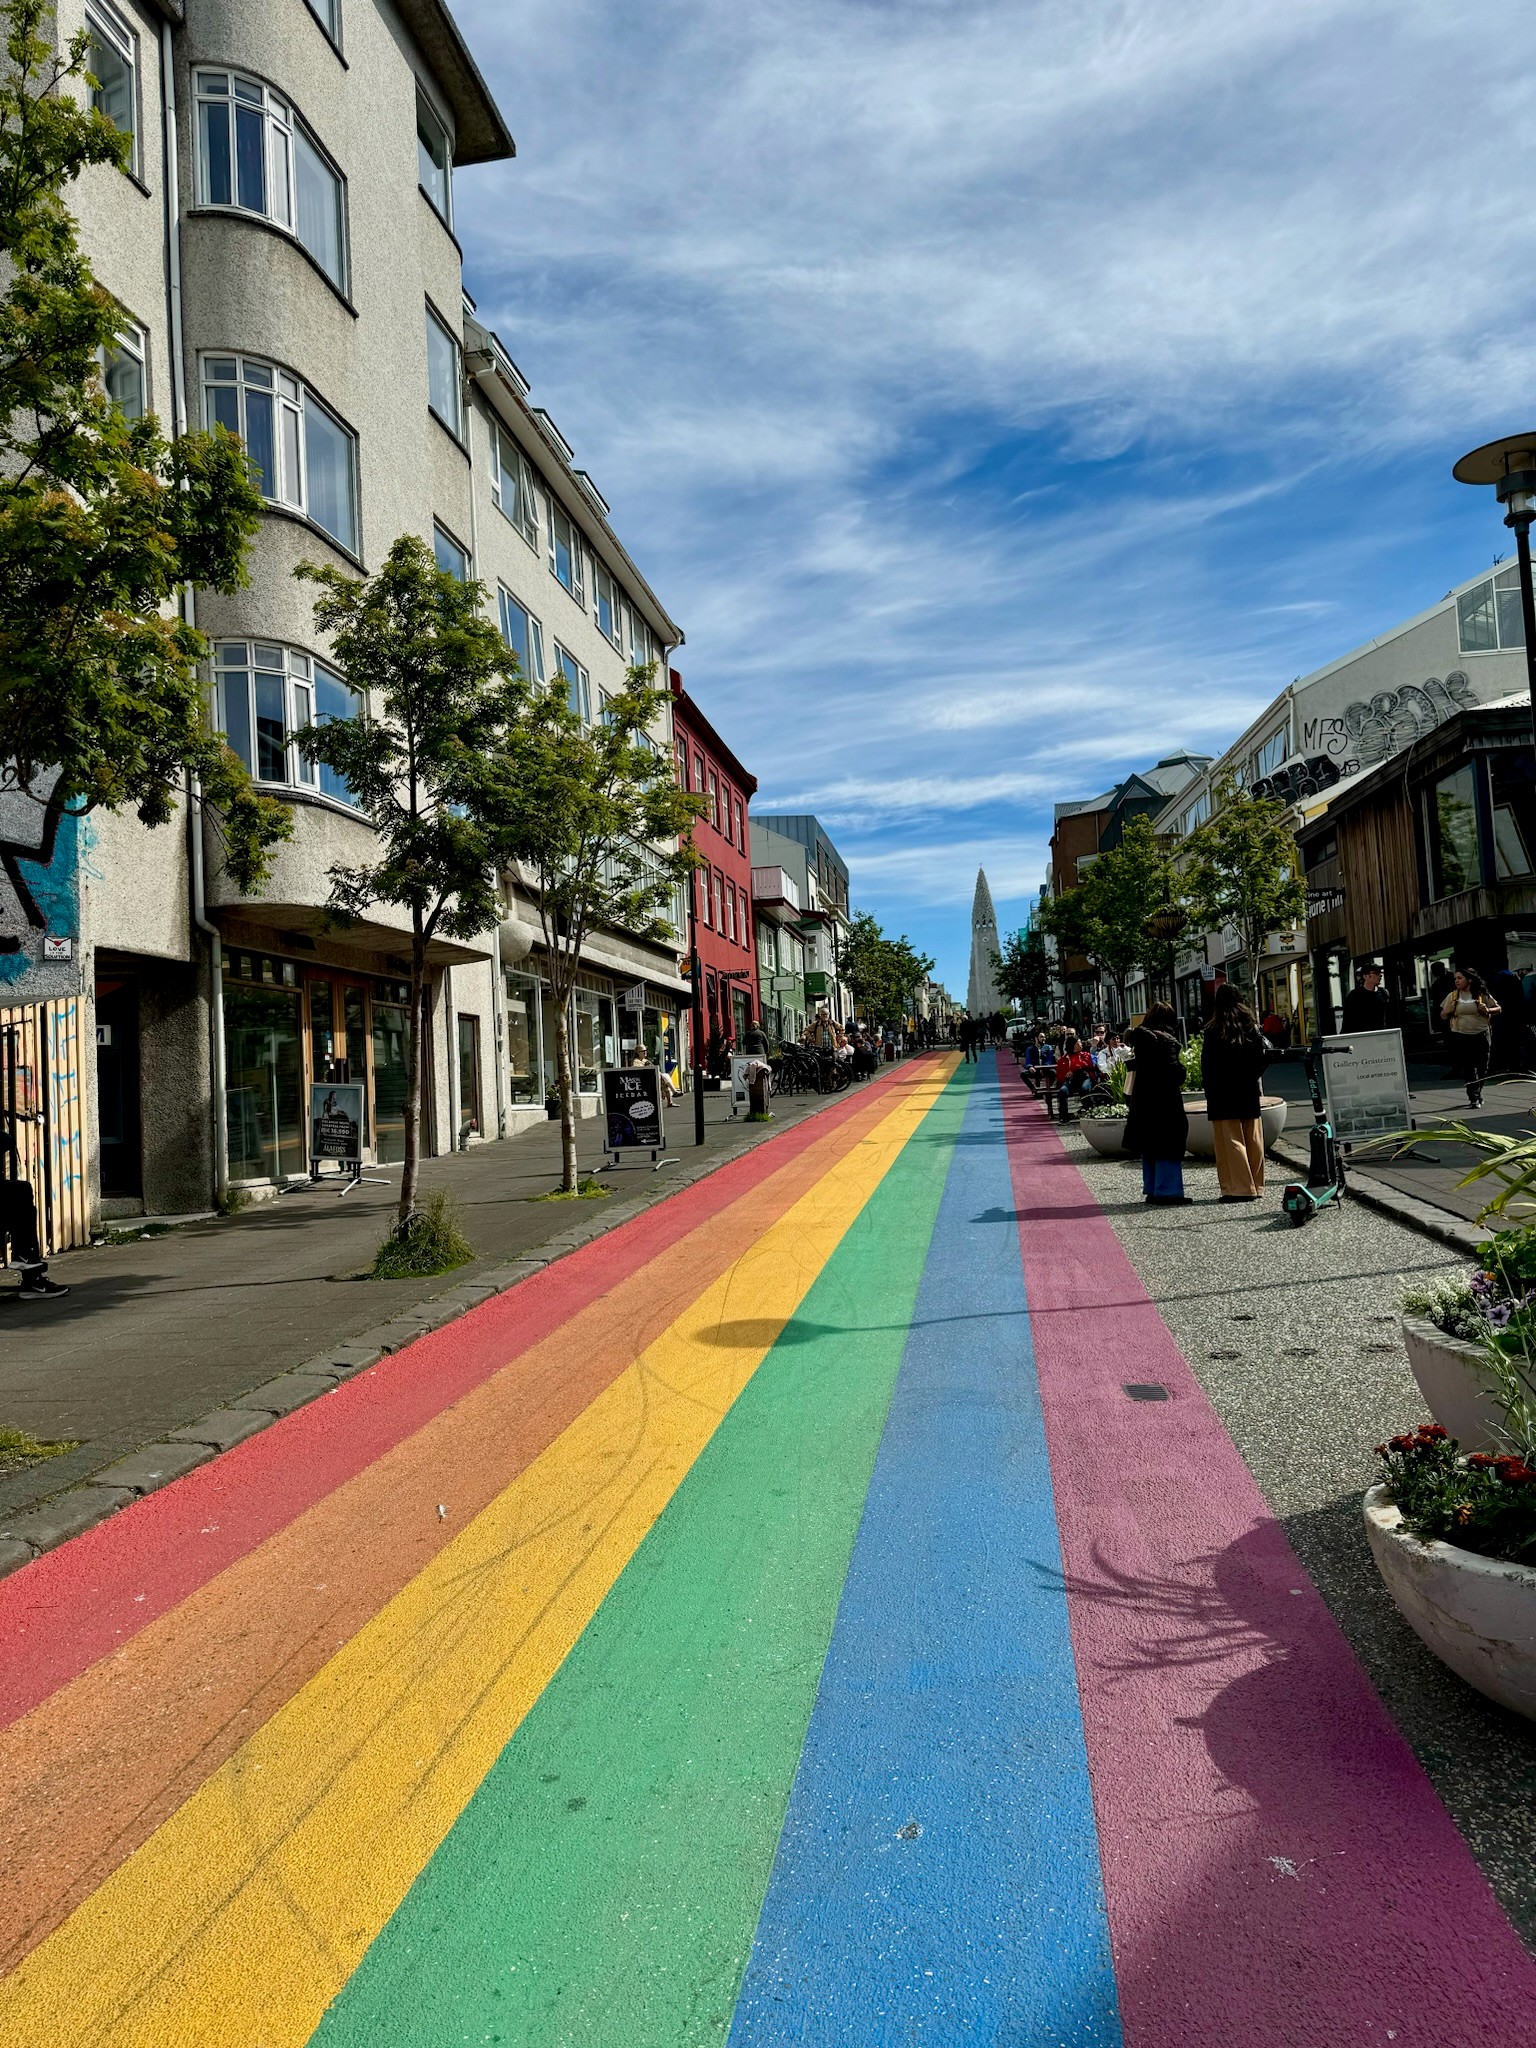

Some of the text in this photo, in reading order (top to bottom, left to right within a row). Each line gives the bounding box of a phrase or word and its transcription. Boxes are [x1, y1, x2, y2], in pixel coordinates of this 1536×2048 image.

[1304, 718, 1348, 755] MFS
[1333, 1059, 1359, 1069] Gallery
[1356, 1072, 1370, 1080] Local
[624, 1082, 642, 1091] ICE
[615, 1091, 648, 1099] ICEBAR
